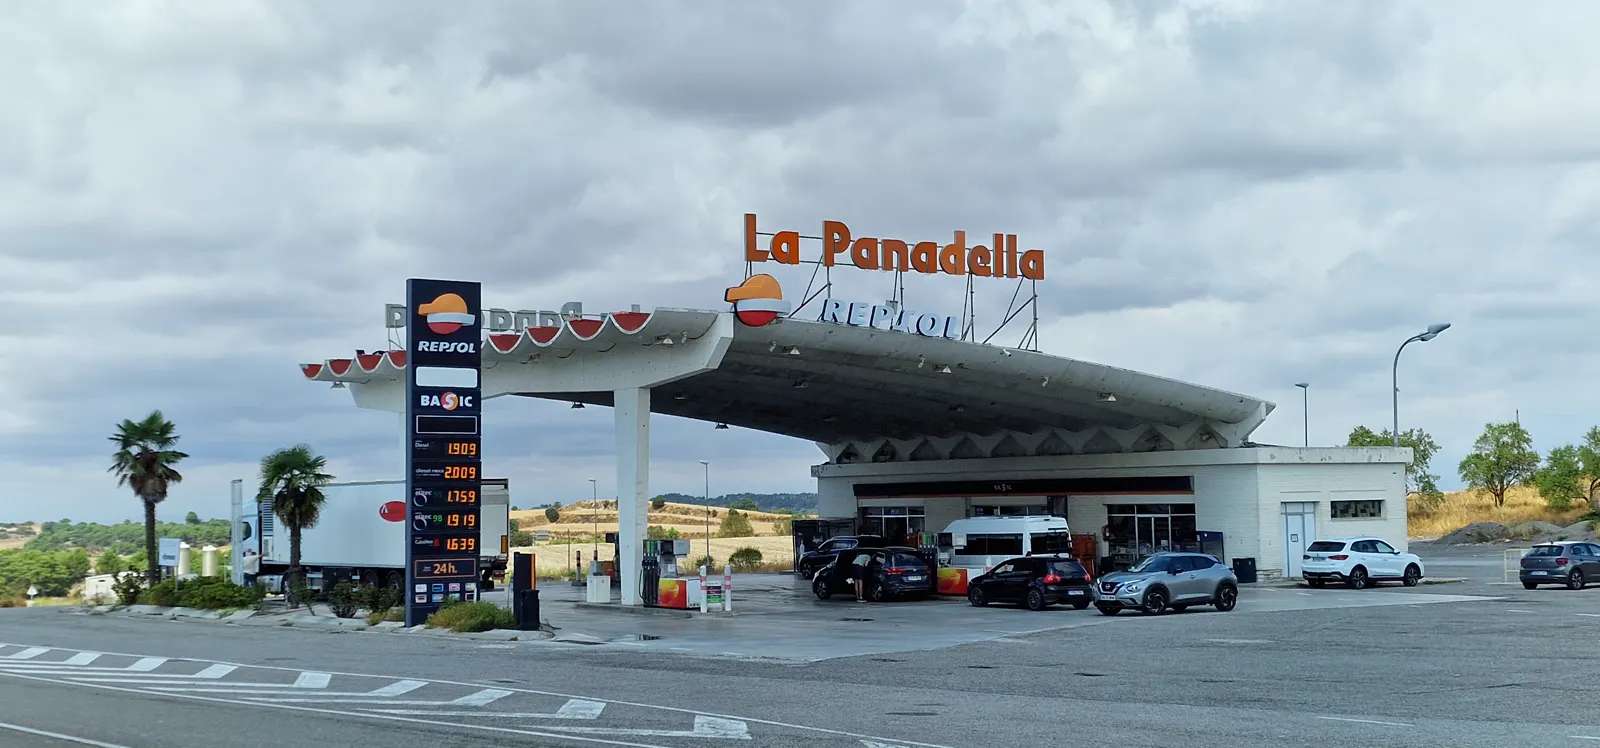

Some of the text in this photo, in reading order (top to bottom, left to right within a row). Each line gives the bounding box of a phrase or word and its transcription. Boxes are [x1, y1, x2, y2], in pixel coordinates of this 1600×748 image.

[744, 213, 1044, 280] La Panadella
[820, 298, 961, 339] REPSOL
[418, 340, 476, 353] REPSOL
[420, 391, 473, 410] BASIC
[448, 443, 477, 455] 1.909
[444, 466, 476, 479] 2.009
[447, 490, 476, 503] 1.759
[432, 514, 443, 522] 98
[447, 514, 476, 526] 1.919
[446, 538, 475, 550] 1.639
